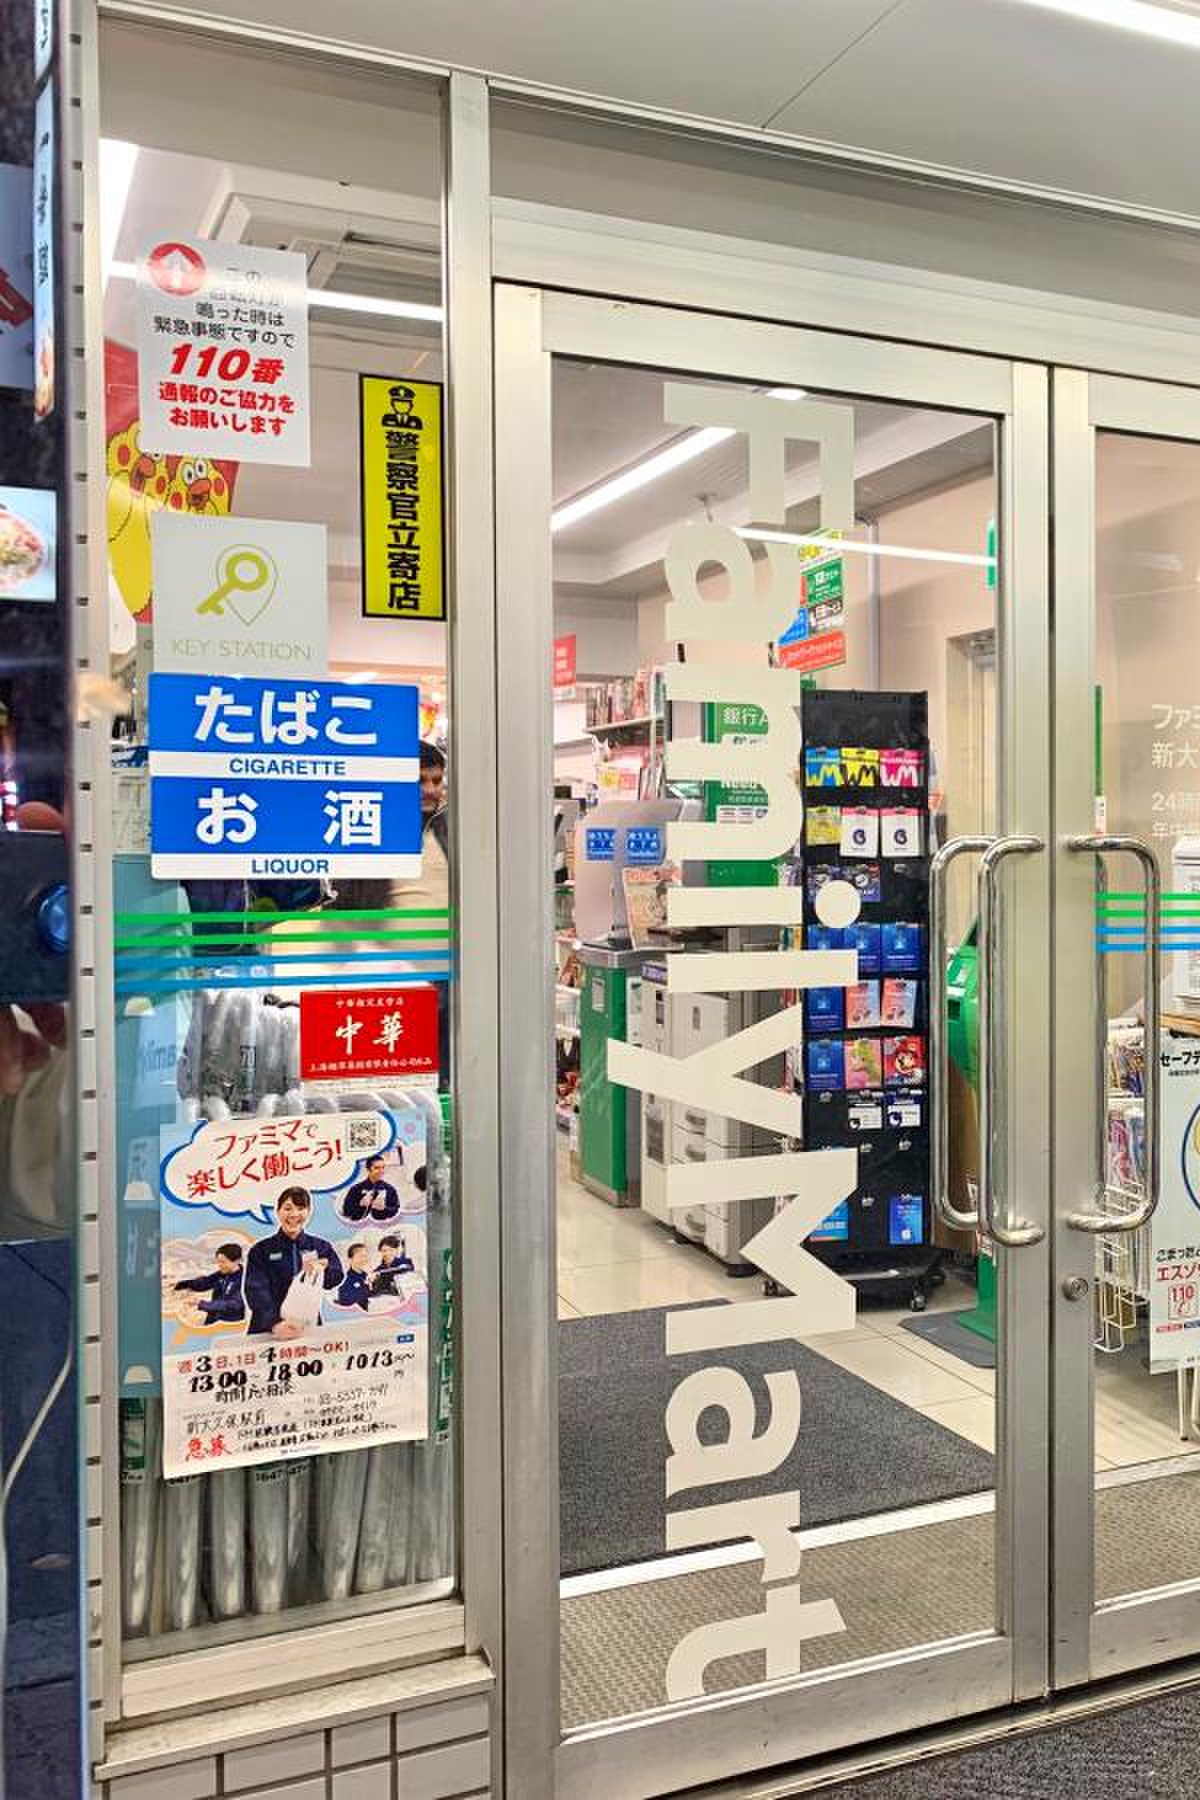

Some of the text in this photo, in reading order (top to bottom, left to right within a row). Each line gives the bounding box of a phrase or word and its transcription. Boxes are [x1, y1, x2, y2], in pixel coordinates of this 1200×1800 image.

[196, 302, 285, 327] 鳴った時は
[154, 316, 296, 349] 緊急事態ですので
[171, 343, 285, 384] 110番
[159, 381, 295, 415] 通報のご協力を
[170, 407, 287, 436] お願いします
[384, 430, 423, 612] 警察官立寄店
[172, 639, 312, 661] KEY STATION
[195, 688, 378, 746] たばこ
[723, 707, 768, 726] 銀行A
[229, 758, 347, 776] CIGARETTE
[252, 859, 329, 876] LIQUOR
[335, 1011, 404, 1055] 中華
[607, 383, 858, 1705] FamilyMart
[214, 1118, 319, 1161] ファミマで
[187, 1139, 342, 1198] 楽しく働こう!
